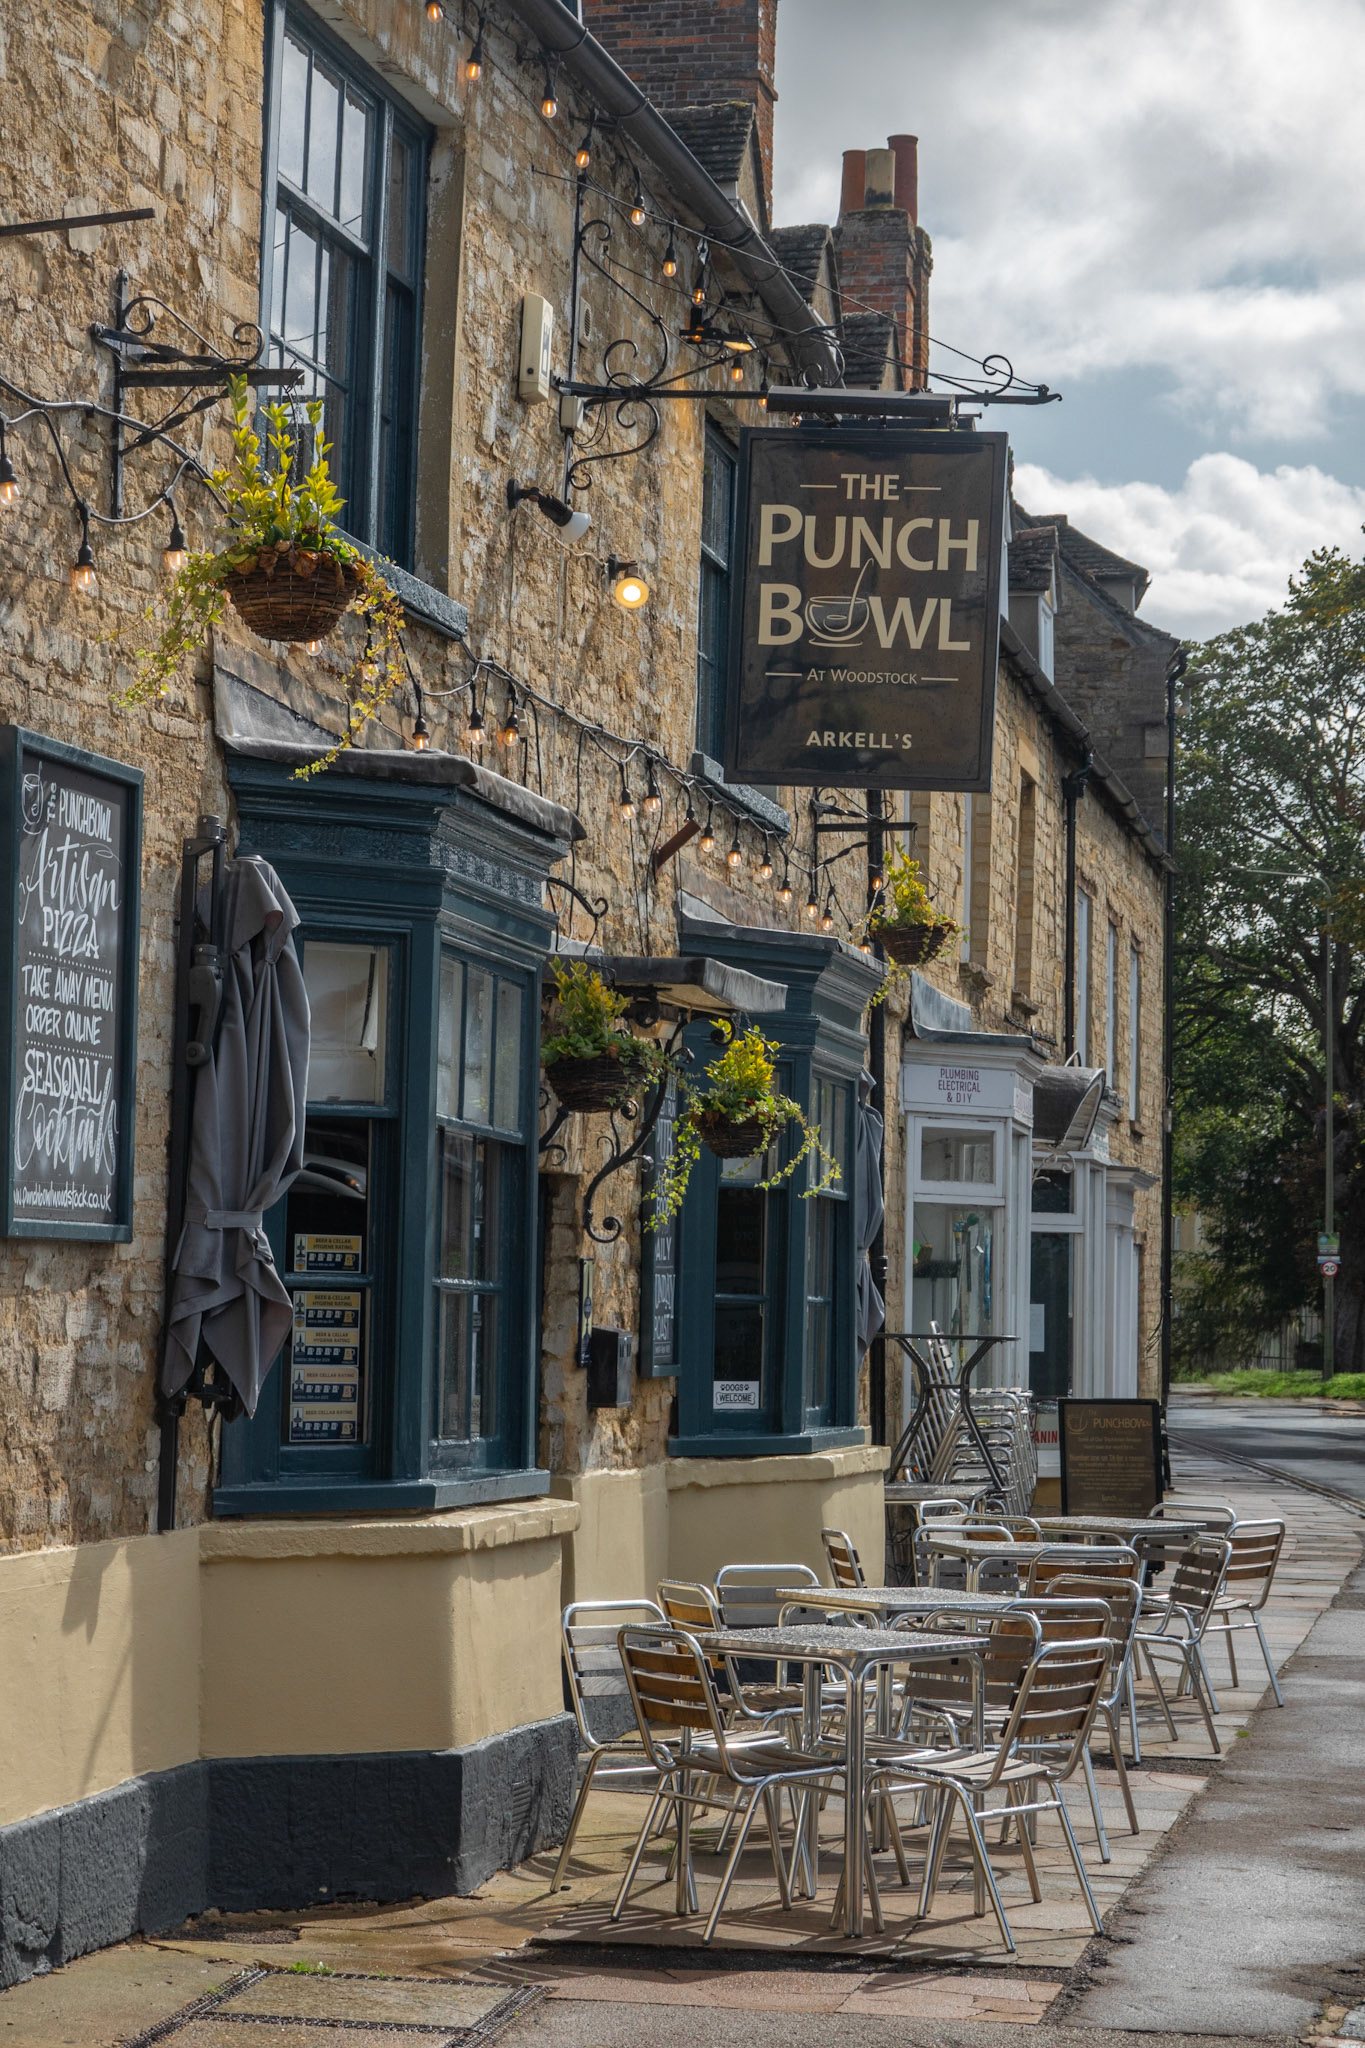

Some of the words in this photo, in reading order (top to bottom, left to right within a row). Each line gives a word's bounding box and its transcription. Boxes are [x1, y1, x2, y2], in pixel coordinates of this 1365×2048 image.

[841, 474, 900, 500] THE
[758, 504, 979, 571] PUNCH
[807, 669, 826, 682] AT
[830, 669, 918, 685] WOODSTOCK
[806, 730, 913, 750] ARKELL'S
[59, 788, 112, 842] PUNCHBOWL
[20, 827, 121, 922] Artisan
[42, 906, 99, 959] PIZZA
[22, 965, 52, 1000] TAKE
[54, 968, 84, 1006] AWAY
[84, 975, 113, 1012] MENU
[26, 1003, 60, 1038] ORDER
[65, 1014, 102, 1046] ONLINE
[23, 1048, 103, 1104] SEASONAL
[938, 1080, 981, 1092] ELECTRICAL
[940, 1068, 979, 1080] PLUMBING
[946, 1092, 953, 1103] &
[719, 1393, 752, 1403] WELCOME
[725, 1383, 744, 1392] DOGS
